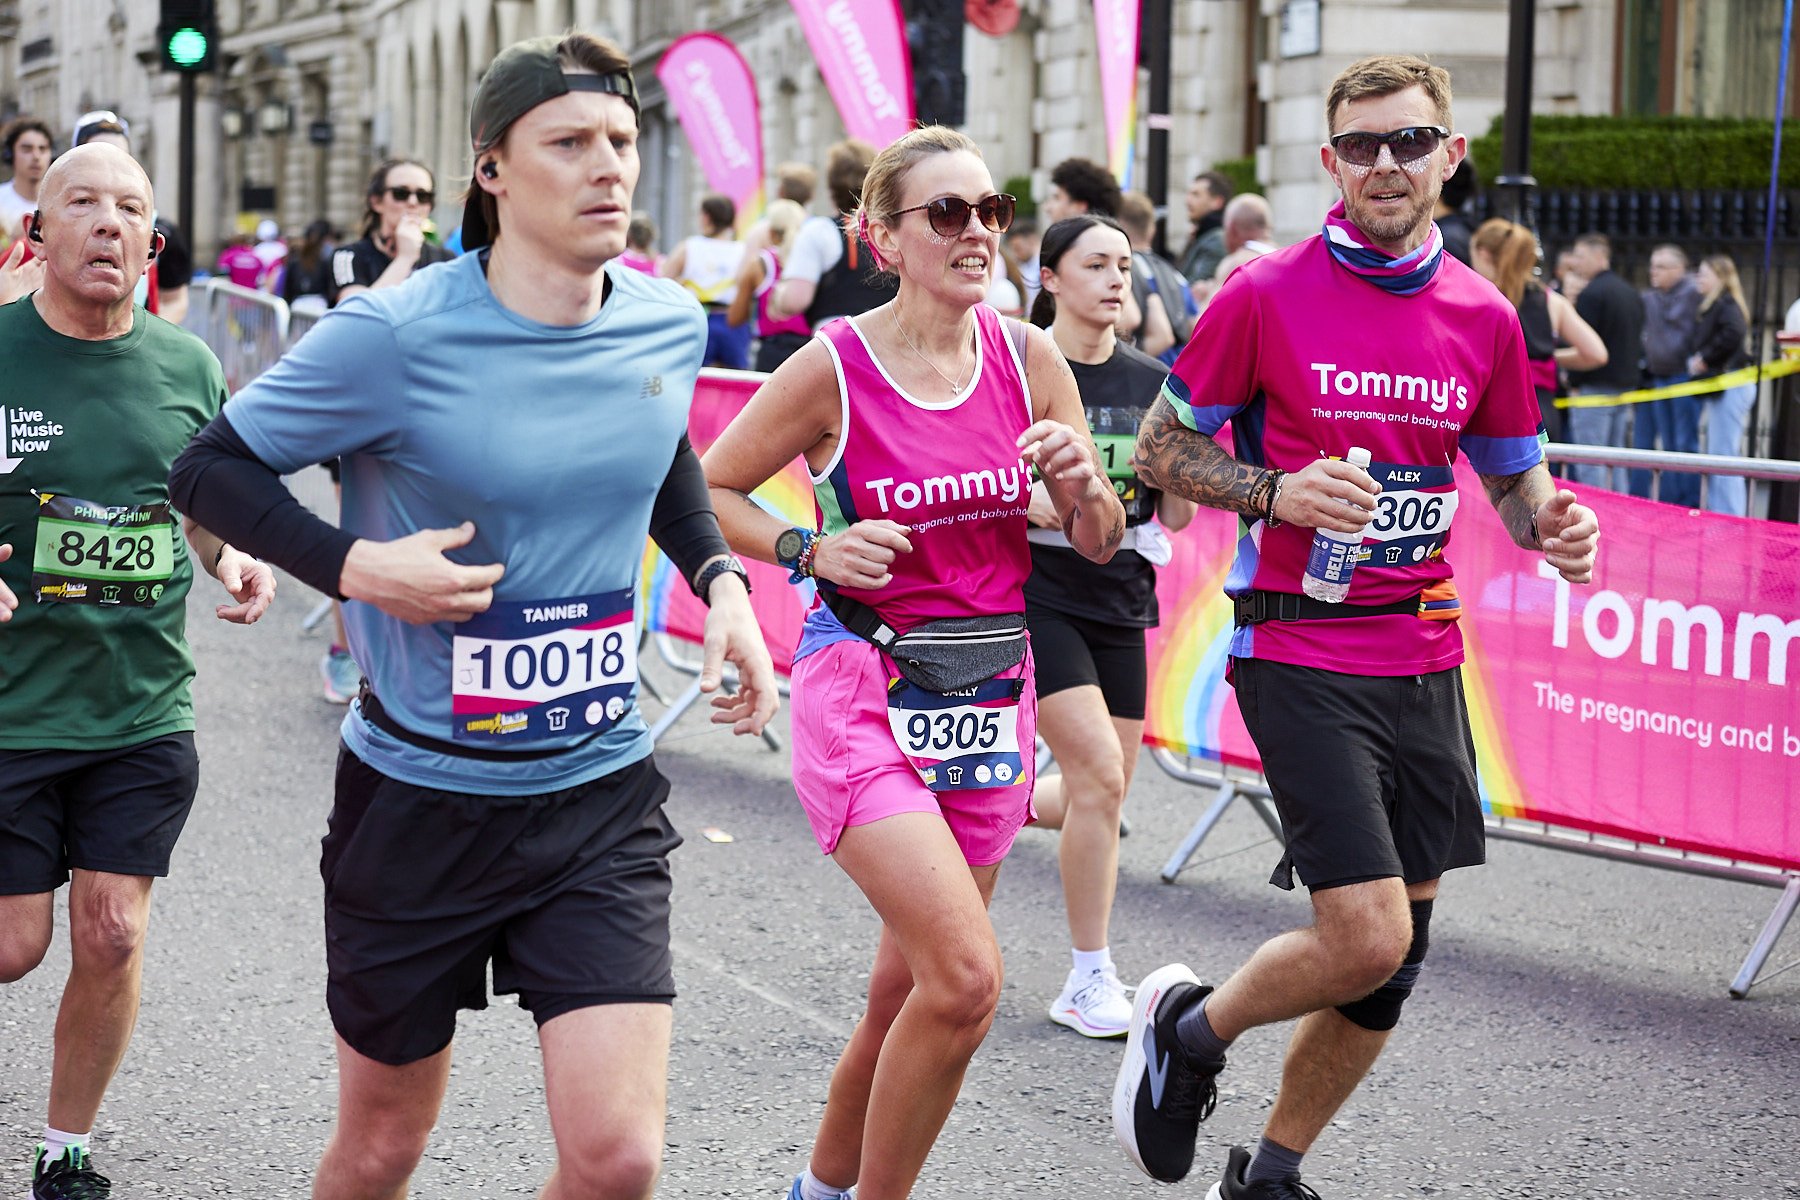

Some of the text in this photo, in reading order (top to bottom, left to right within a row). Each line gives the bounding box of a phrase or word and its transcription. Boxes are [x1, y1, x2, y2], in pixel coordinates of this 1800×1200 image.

[1310, 362, 1468, 413] Tommy's
[10, 407, 43, 422] Live
[11, 420, 64, 438] Music
[1311, 407, 1332, 418] The
[1334, 409, 1386, 423] pregnancy
[1387, 412, 1409, 423] and
[1411, 414, 1438, 429] baby
[11, 438, 50, 453] Now
[865, 458, 1033, 513] Tommy's
[1386, 470, 1421, 483] ALEX
[74, 505, 152, 524] PHILIP SHINN
[908, 506, 1028, 534] egnancy and baby cha
[1372, 496, 1443, 532] 306
[57, 530, 155, 572] 8428
[1324, 543, 1347, 581] BELU
[522, 603, 589, 624] TANNER
[1537, 559, 1800, 686] Tomm
[470, 631, 625, 690] 10018
[907, 711, 1000, 751] 9305
[1533, 681, 1800, 757] The pregnancy and b
